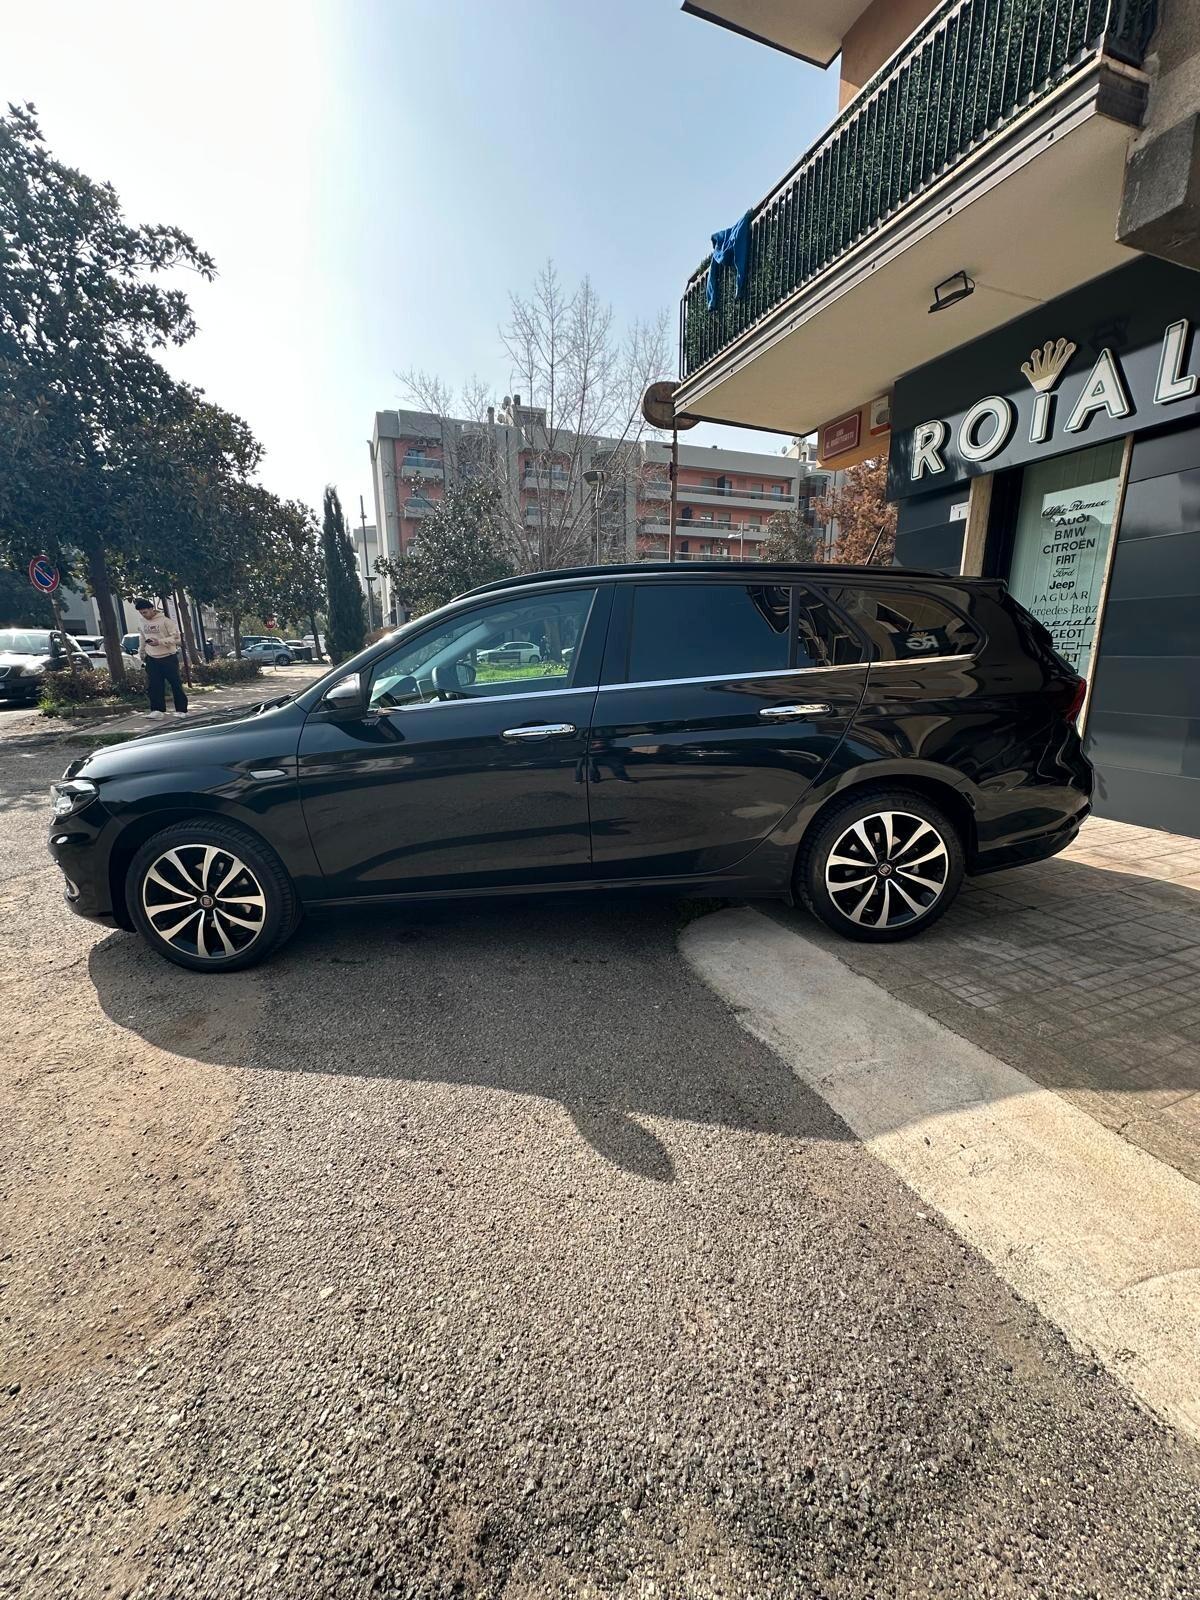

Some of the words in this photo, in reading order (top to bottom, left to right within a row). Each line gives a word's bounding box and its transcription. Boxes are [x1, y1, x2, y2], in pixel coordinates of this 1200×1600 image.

[1068, 500, 1109, 512] Romeo
[1055, 513, 1090, 527] Audi
[1054, 526, 1087, 540] BMW
[1056, 554, 1076, 565] FIAT
[1053, 567, 1075, 578] Ford
[1049, 581, 1075, 590] Jeep
[1034, 590, 1088, 604] JAGUAR
[1050, 629, 1084, 638] GEOT
